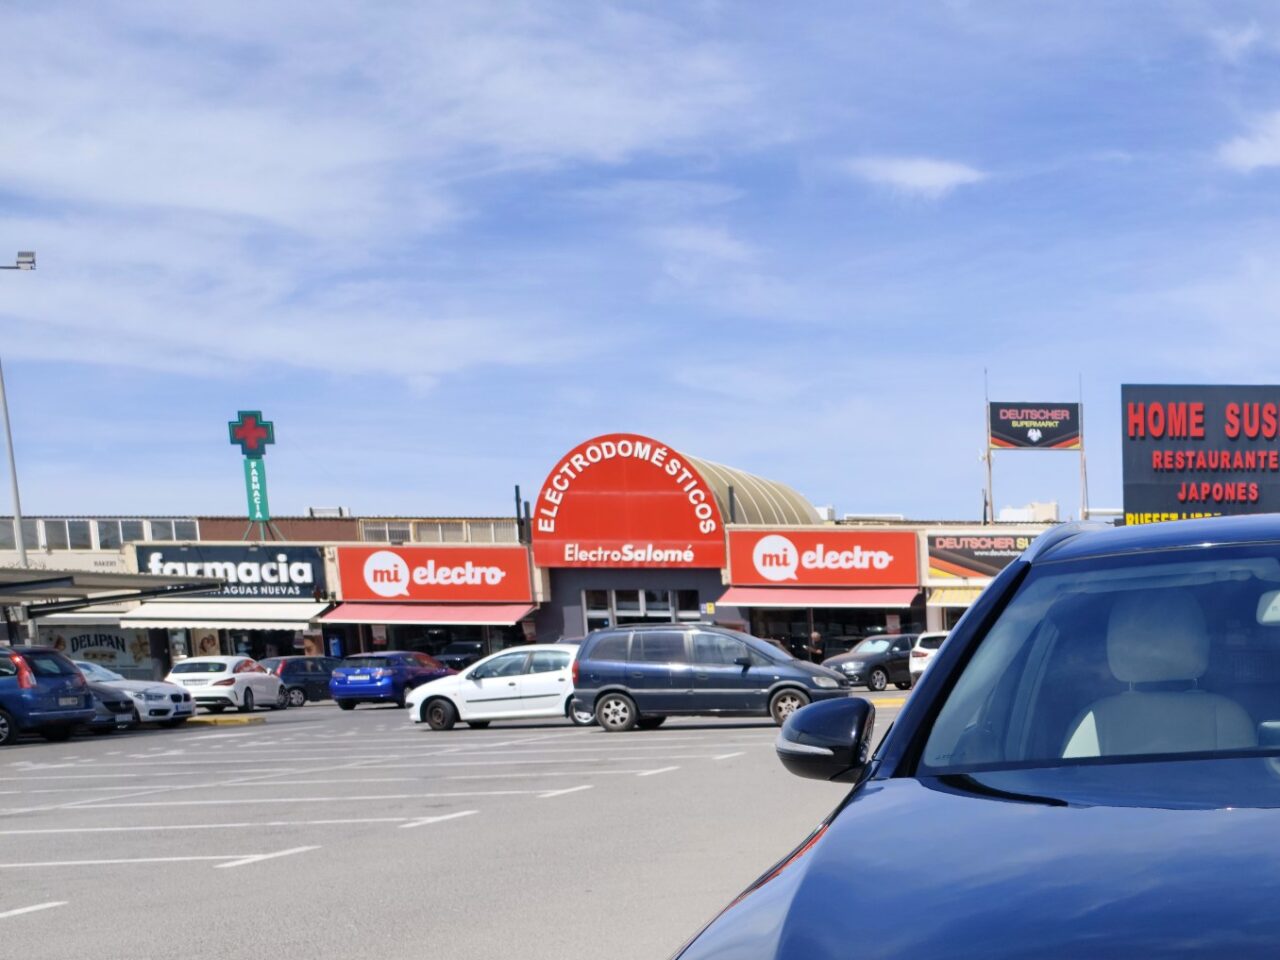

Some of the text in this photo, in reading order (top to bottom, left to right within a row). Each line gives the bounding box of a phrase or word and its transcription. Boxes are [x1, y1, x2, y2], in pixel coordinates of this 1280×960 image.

[999, 408, 1070, 420] DEUTSCHER
[1011, 420, 1060, 428] SUPERMARKT
[1127, 402, 1204, 438] HOME
[1152, 450, 1279, 470] RESTAURANTE
[250, 461, 263, 519] FARMACIA
[538, 439, 716, 535] ELECTRODOMÉSTICOS
[1177, 482, 1259, 501] JAPONES
[564, 543, 694, 563] ElectroSalomé
[935, 537, 1015, 549] DEUTSCHER
[762, 543, 894, 569] mi electro
[148, 552, 314, 583] farmacia
[372, 560, 505, 586] mi electro
[223, 586, 258, 595] AGUAS
[261, 586, 301, 595] NUEVAS
[71, 633, 127, 653] DELIPAN
